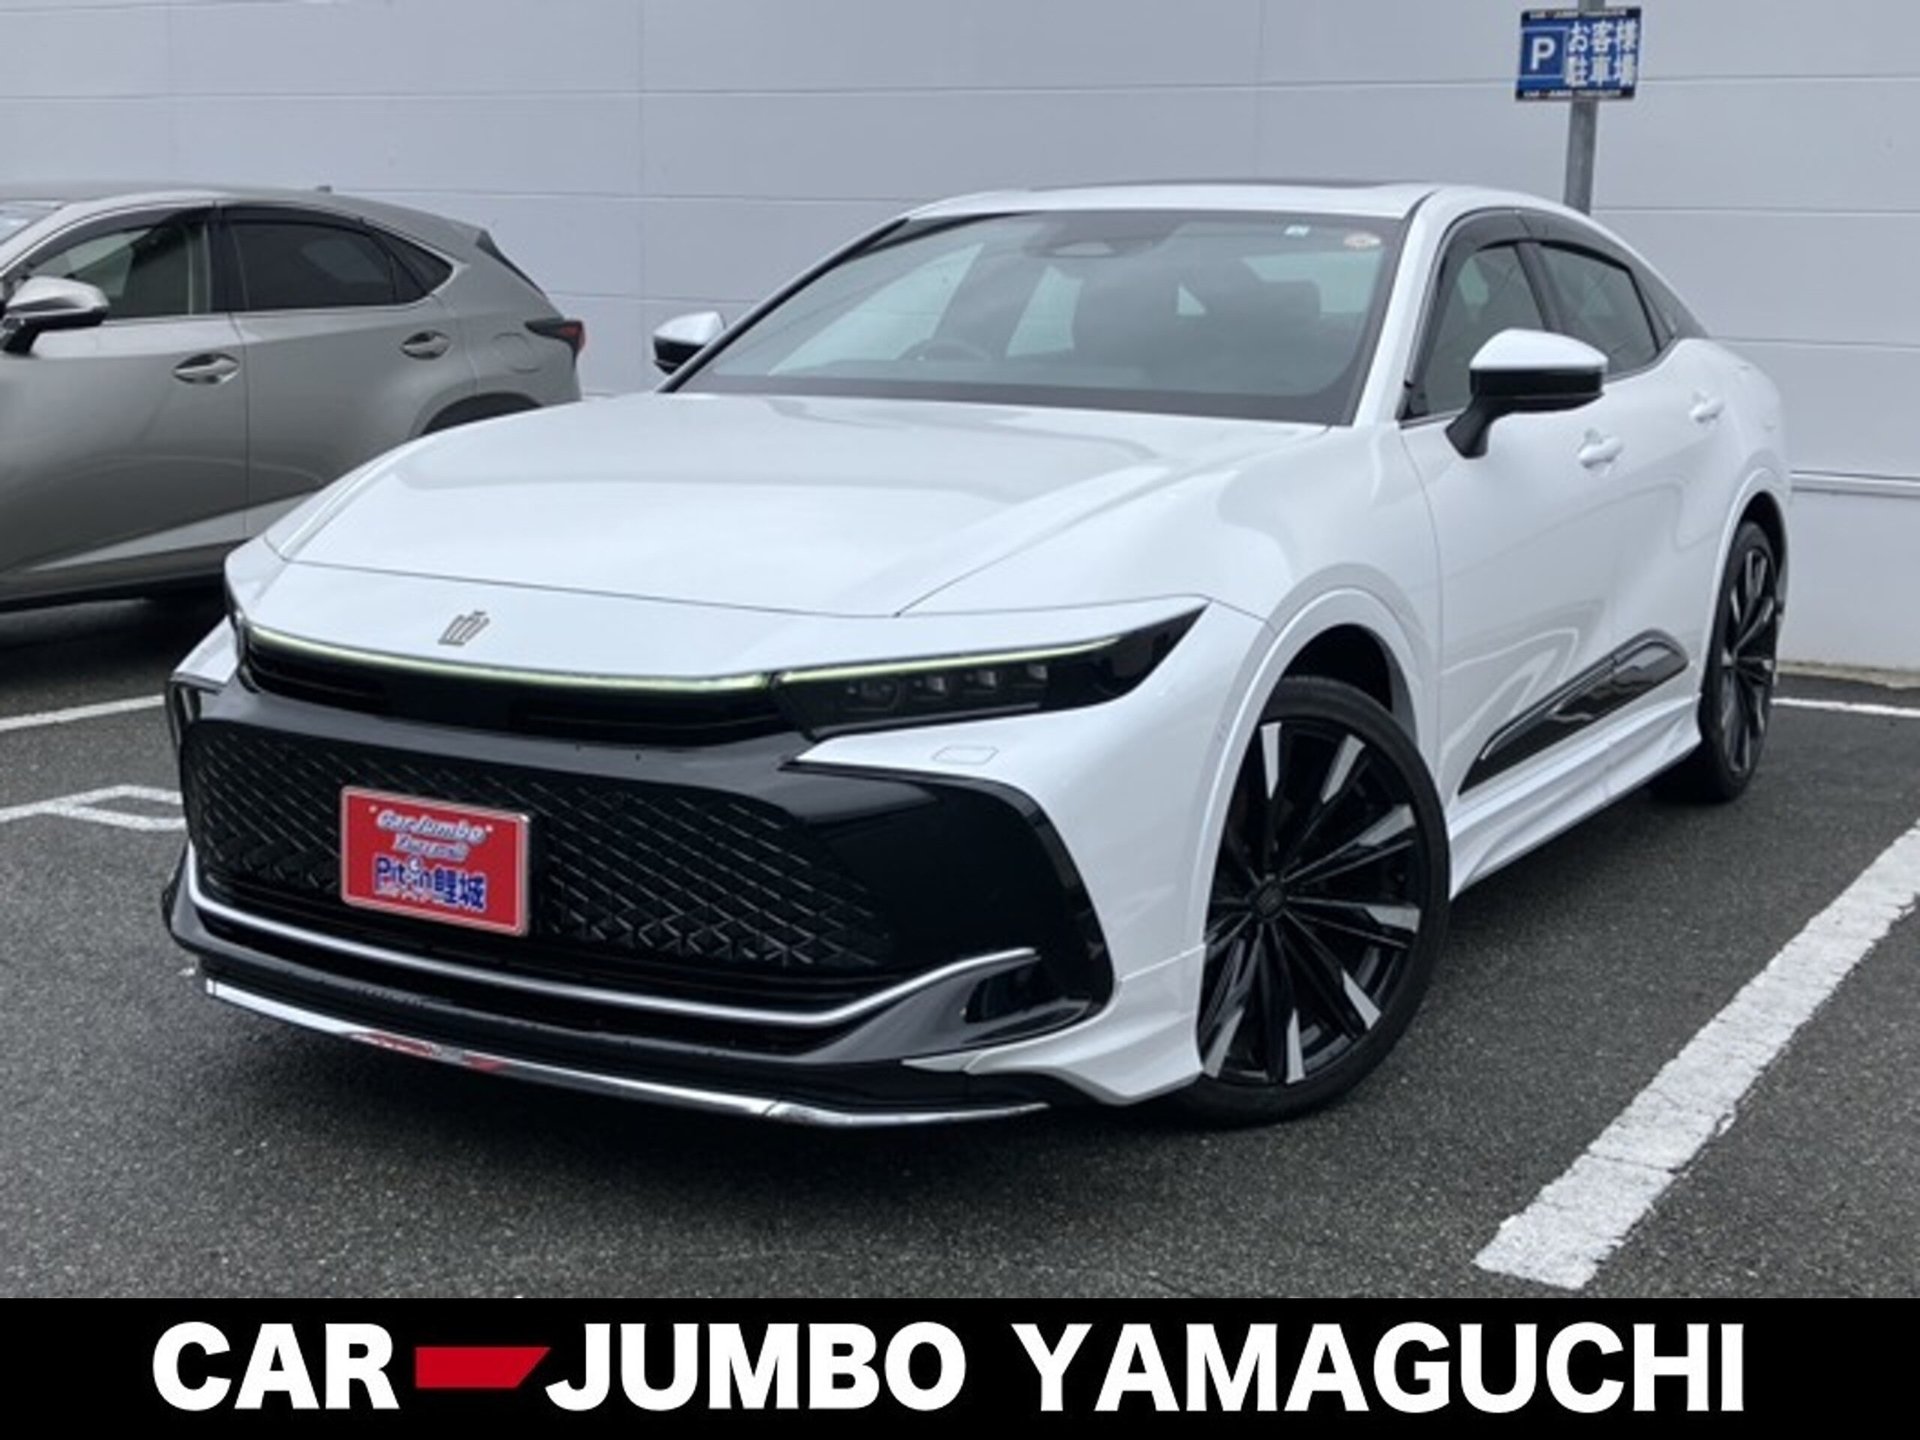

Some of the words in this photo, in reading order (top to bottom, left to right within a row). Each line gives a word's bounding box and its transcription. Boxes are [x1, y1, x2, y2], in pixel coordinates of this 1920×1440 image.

[1530, 36, 1556, 71] P
[1567, 20, 1638, 53] お客様
